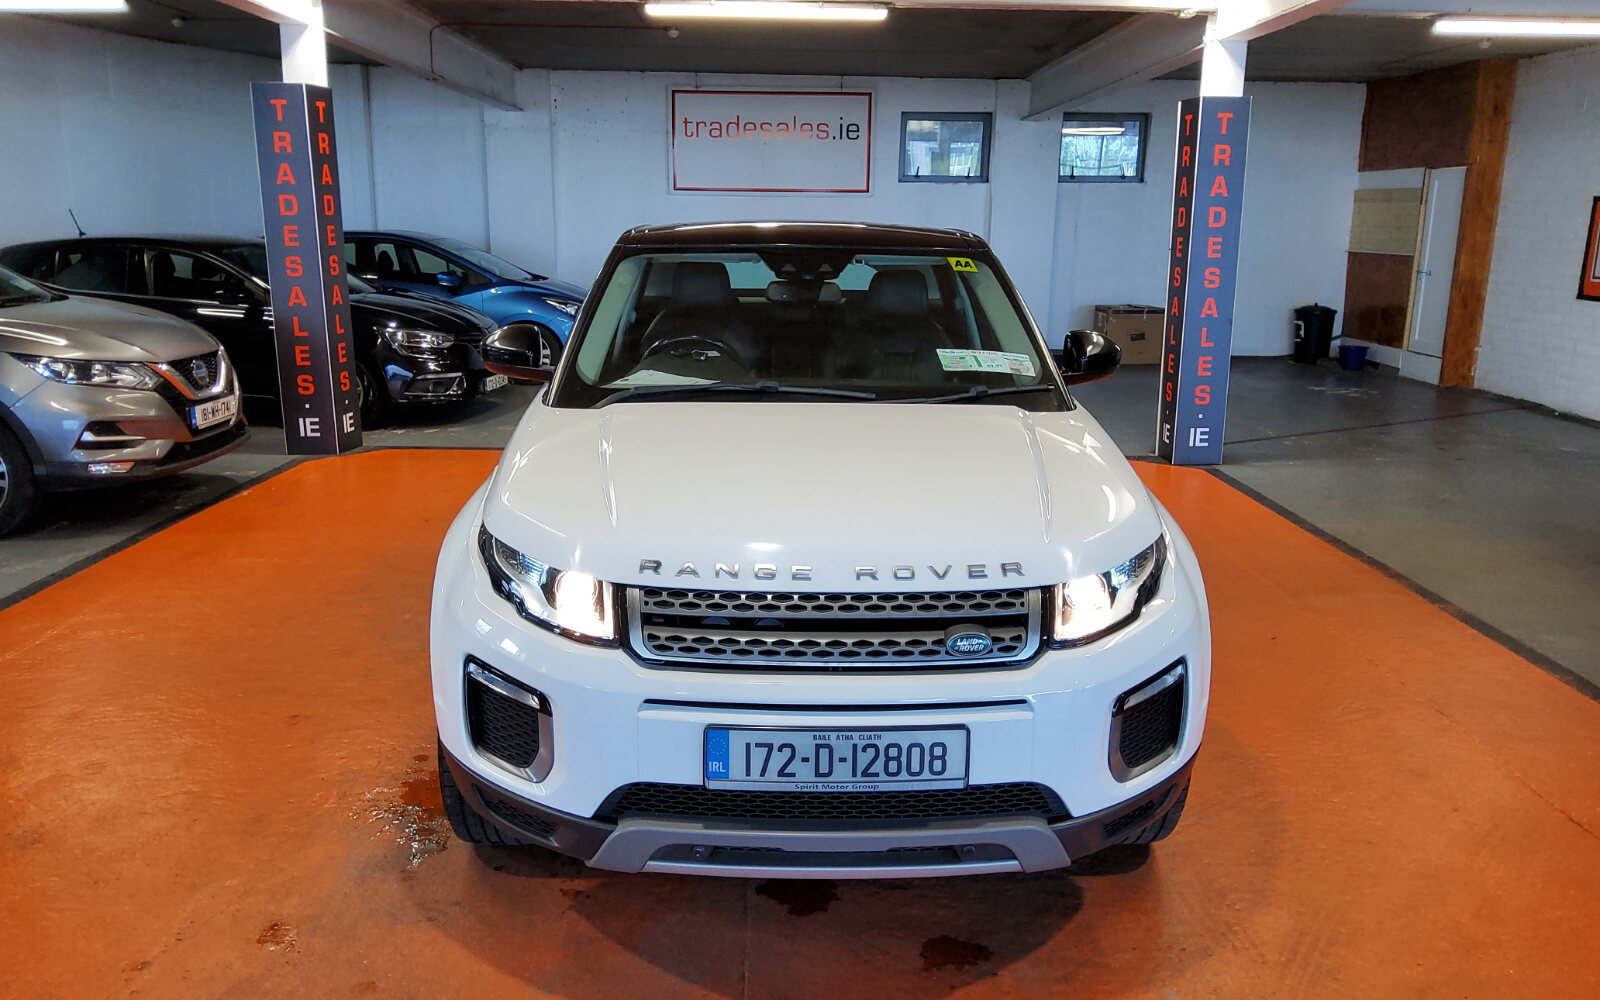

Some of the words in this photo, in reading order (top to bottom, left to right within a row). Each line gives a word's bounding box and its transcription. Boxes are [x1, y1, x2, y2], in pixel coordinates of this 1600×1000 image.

[682, 115, 861, 141] tradesales.ie
[955, 260, 973, 268] AA
[638, 558, 813, 581] RANGE
[855, 561, 1025, 581] ROVER
[835, 732, 854, 741] ÁTHA
[858, 733, 882, 741] CLIATH
[745, 741, 948, 778] 172-D-12808
[708, 761, 727, 773] IRL
[794, 783, 820, 791] Spirit
[851, 783, 880, 791] Group
